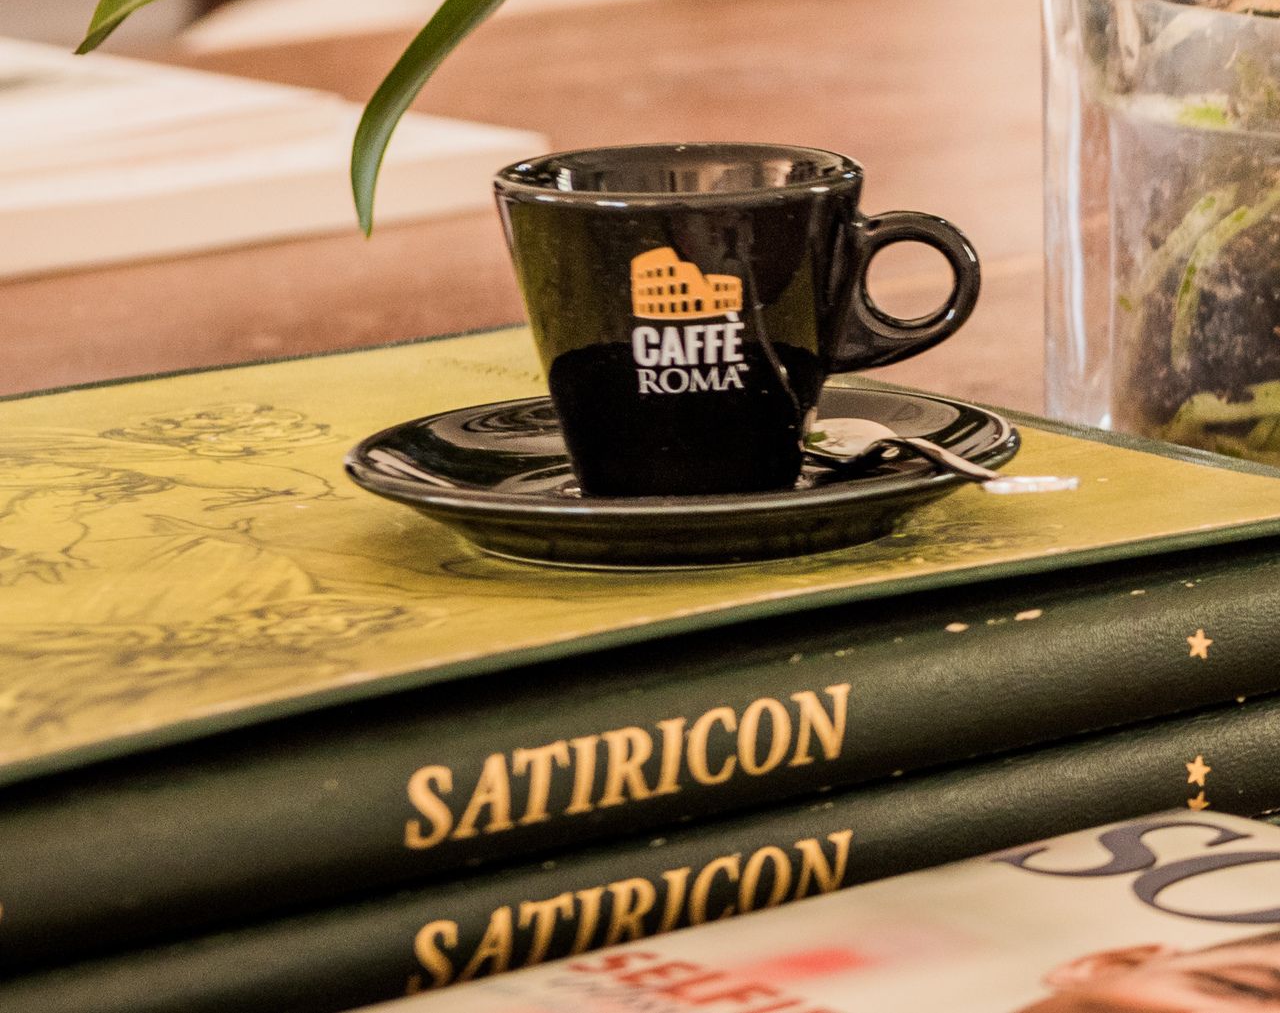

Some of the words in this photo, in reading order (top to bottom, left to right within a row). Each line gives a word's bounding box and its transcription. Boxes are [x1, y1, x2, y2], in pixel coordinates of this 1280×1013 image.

[632, 310, 745, 367] CAFFÈ
[404, 682, 852, 851] SATIRICON
[405, 828, 854, 994] SATIRICON
[566, 950, 838, 1013] SELFI
